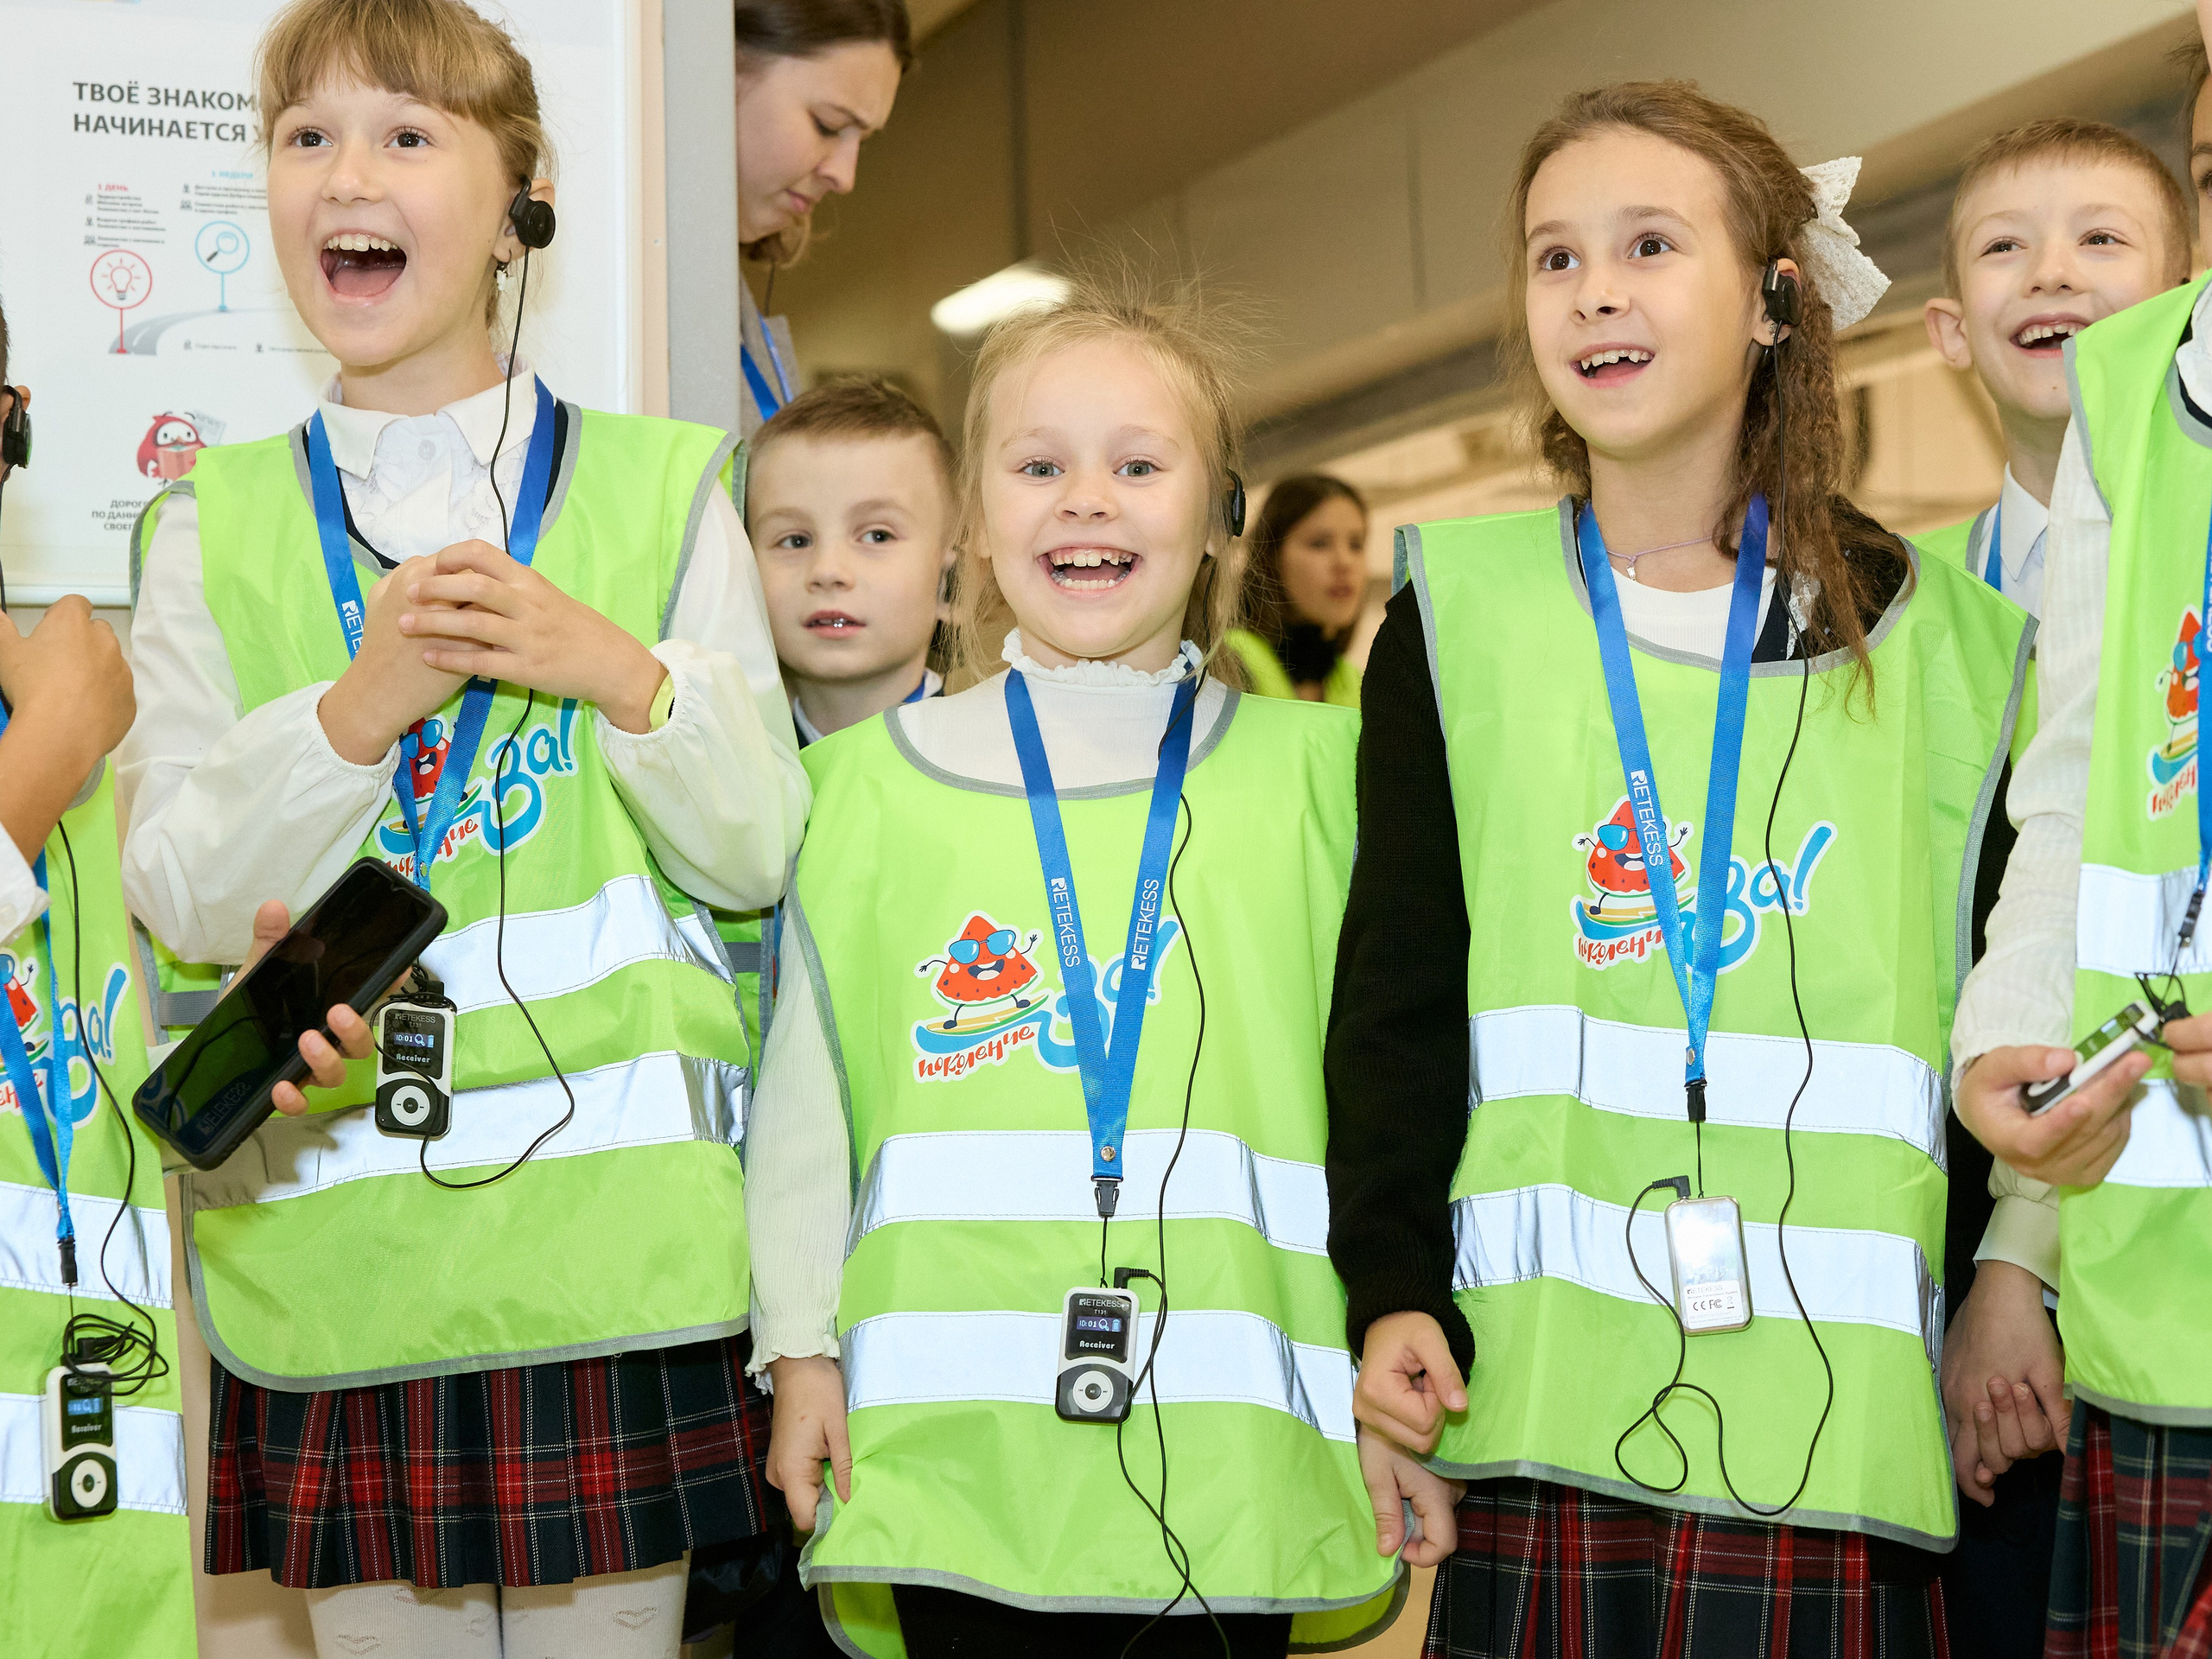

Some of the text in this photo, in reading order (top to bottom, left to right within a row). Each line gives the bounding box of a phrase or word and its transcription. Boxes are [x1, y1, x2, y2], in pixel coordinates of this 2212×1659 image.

[73, 80, 140, 105] ТВОЁ
[73, 113, 246, 143] НАЧИНАЕТСЯ
[341, 600, 364, 653] RETE
[1630, 769, 1663, 867] RETEKESS
[1051, 877, 1080, 968] RETEKESS
[1131, 878, 1160, 971] RETEKESS
[1578, 930, 1664, 964] поколени
[395, 1013, 436, 1023] RETEKESS
[396, 1052, 431, 1063] Receiver
[918, 1026, 1035, 1077] поколение
[1078, 1298, 1122, 1308] RETEKESS
[1079, 1340, 1116, 1350] Receiver
